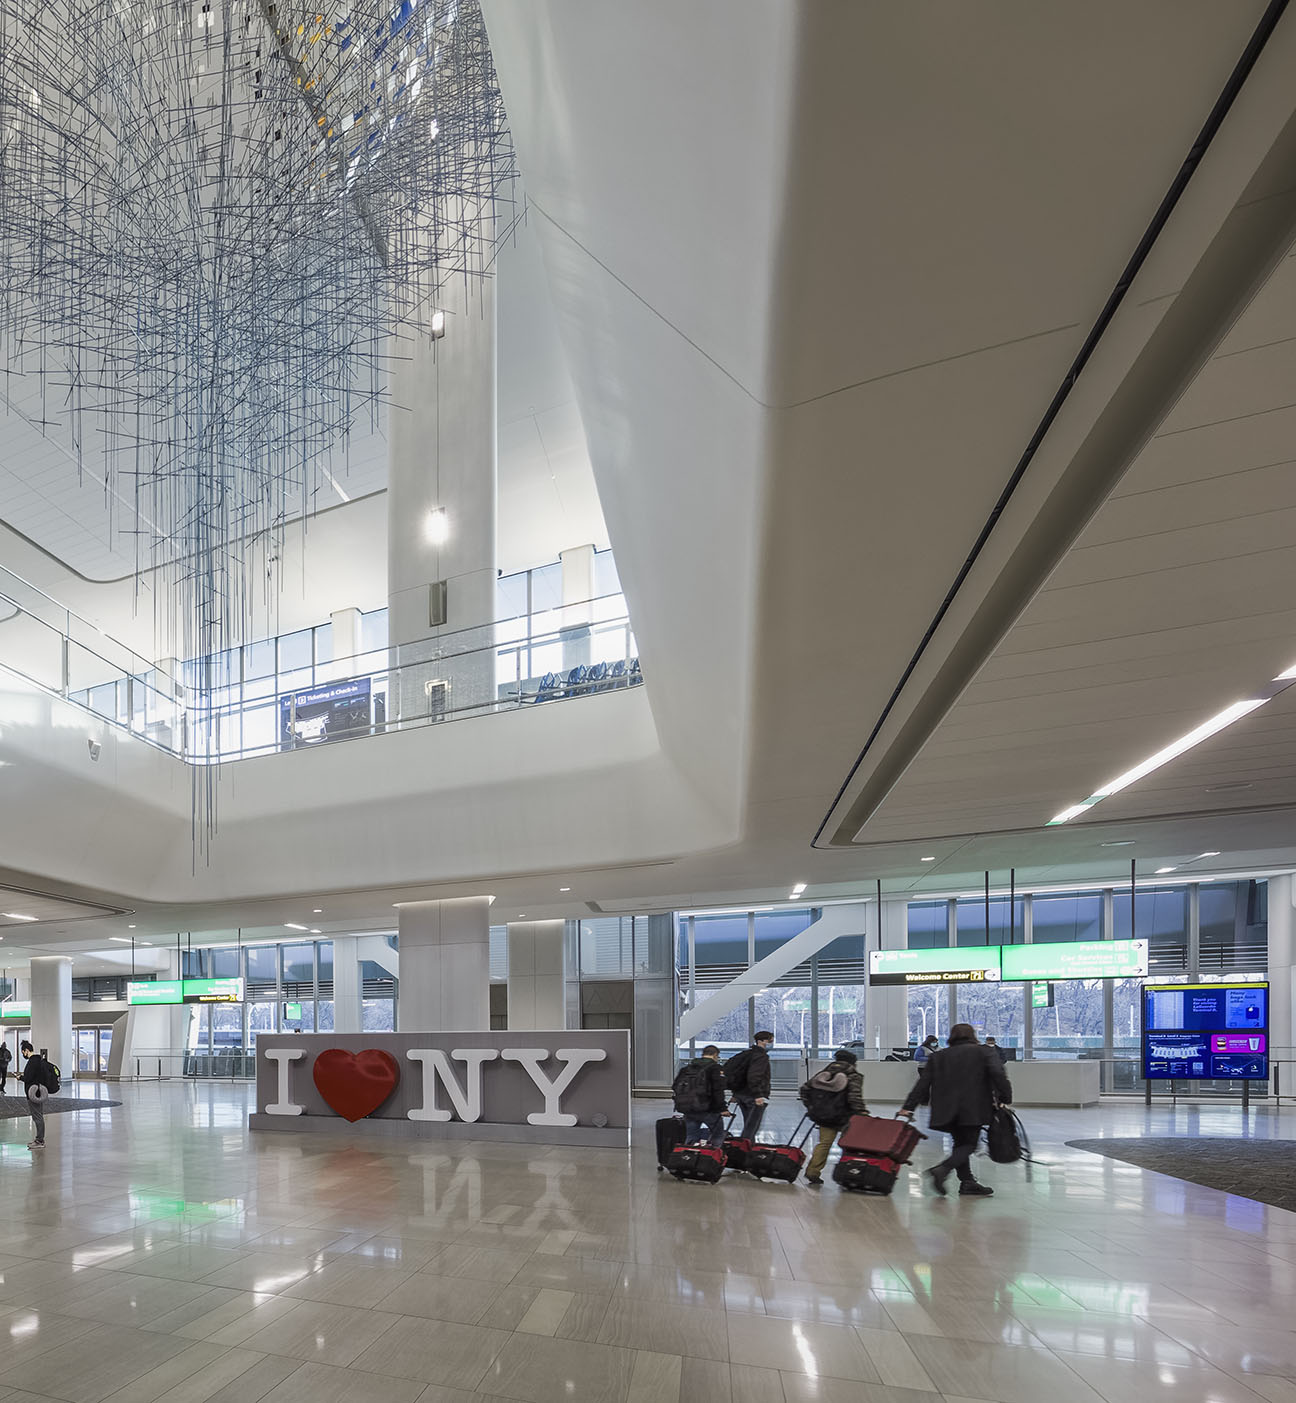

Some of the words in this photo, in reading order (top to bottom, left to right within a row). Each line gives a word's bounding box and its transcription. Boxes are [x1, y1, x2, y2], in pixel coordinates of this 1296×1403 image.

[942, 972, 970, 980] Center
[264, 1048, 307, 1116] I
[406, 1047, 608, 1127] NY
